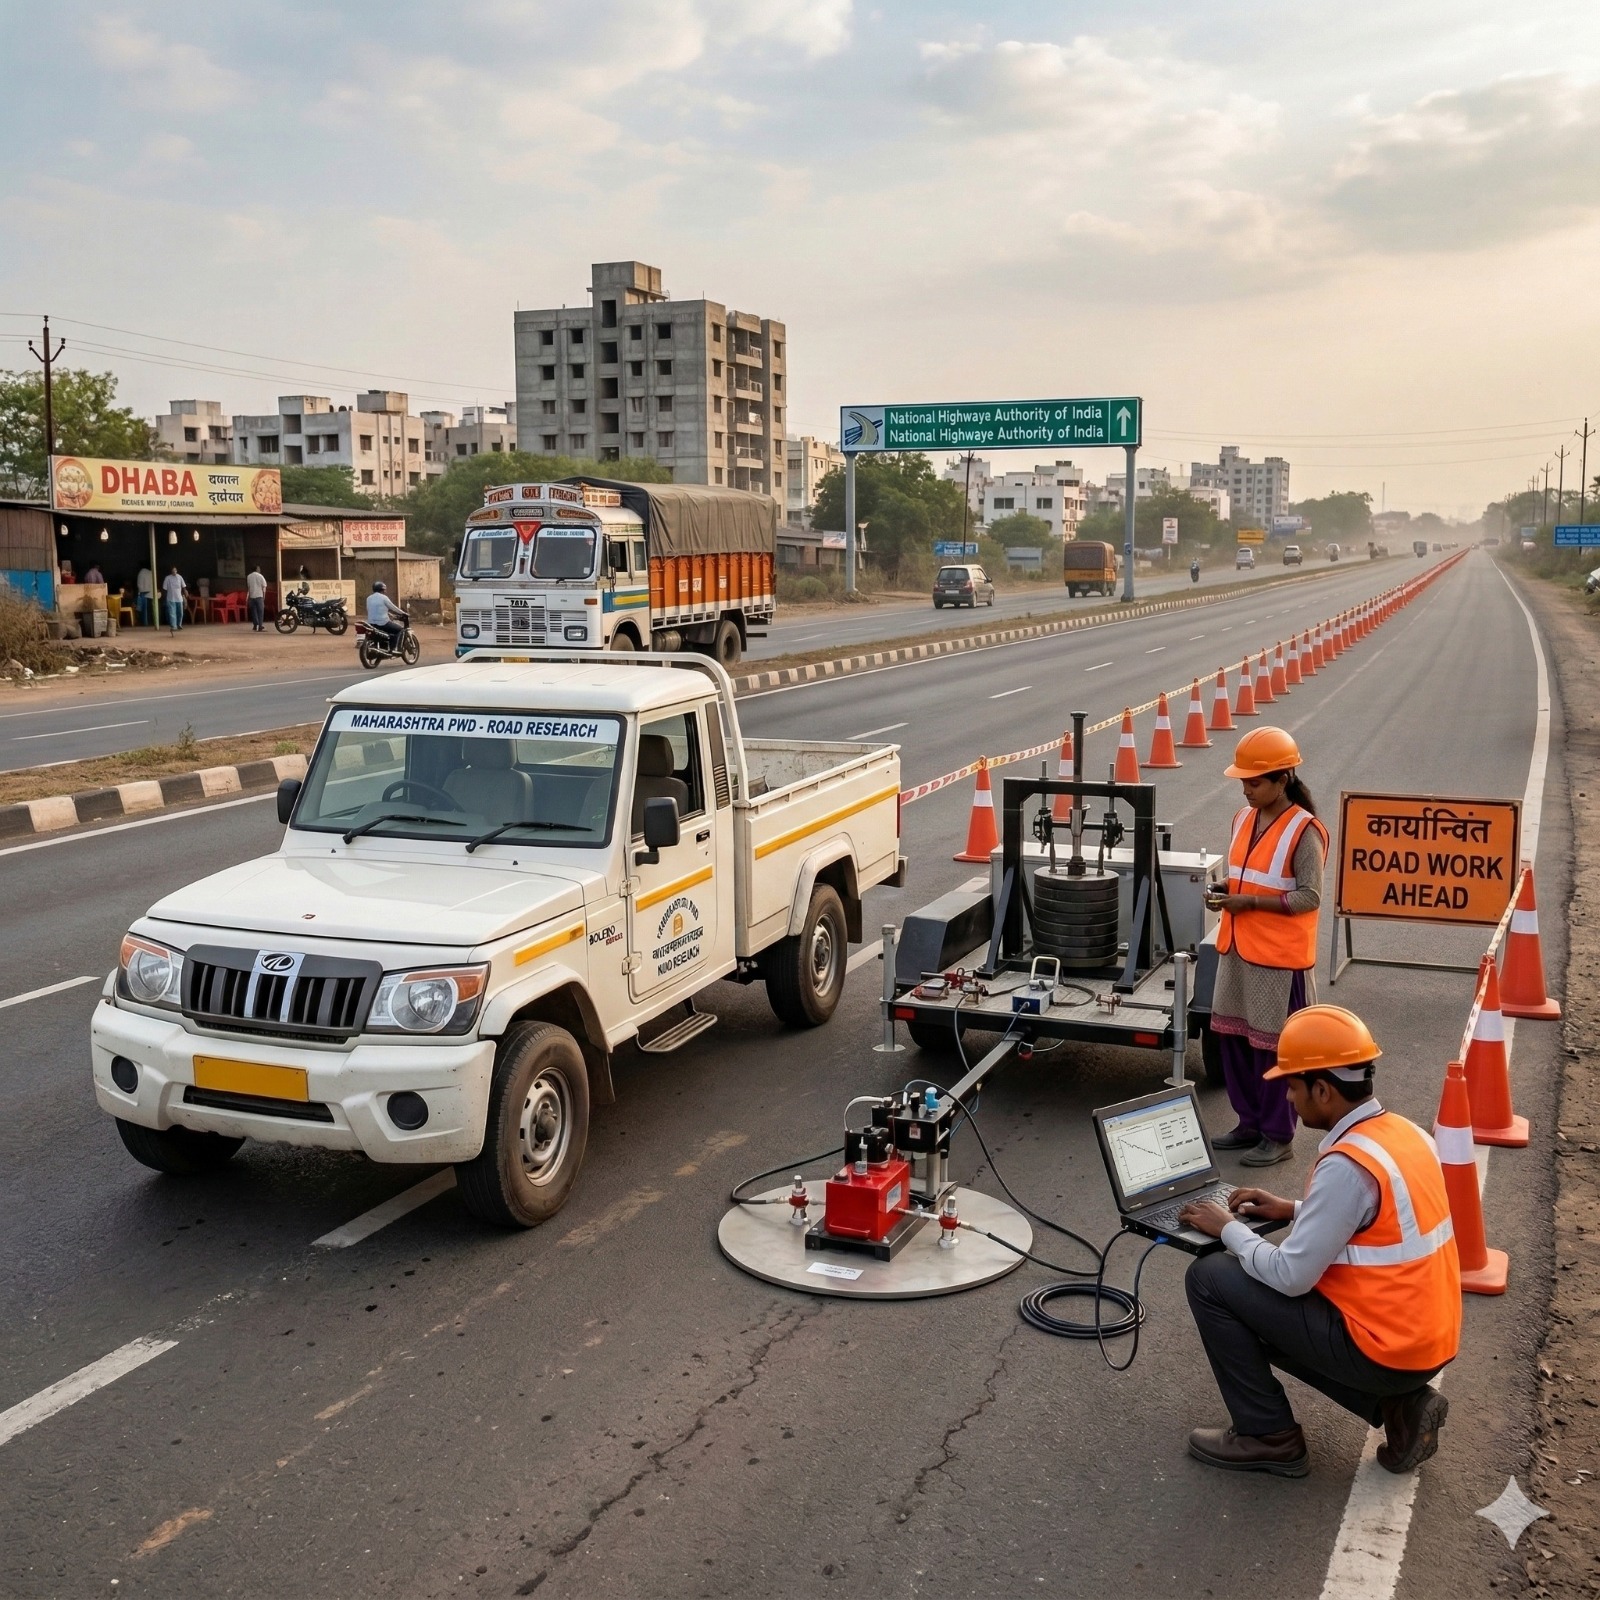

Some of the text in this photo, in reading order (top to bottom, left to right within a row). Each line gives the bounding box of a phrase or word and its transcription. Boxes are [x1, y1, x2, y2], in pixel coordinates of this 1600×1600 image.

[890, 405, 1102, 425] National Highwaye Authority of India
[889, 424, 1104, 443] National Highwaye Authority of India
[101, 465, 198, 497] DHABA
[351, 714, 445, 731] MAHARASHTRA
[448, 718, 477, 733] PWD
[486, 719, 523, 735] ROAD
[526, 722, 598, 738] RESEARCH
[1351, 848, 1504, 880] ROAD WORK
[1382, 882, 1469, 910] AHEAD
